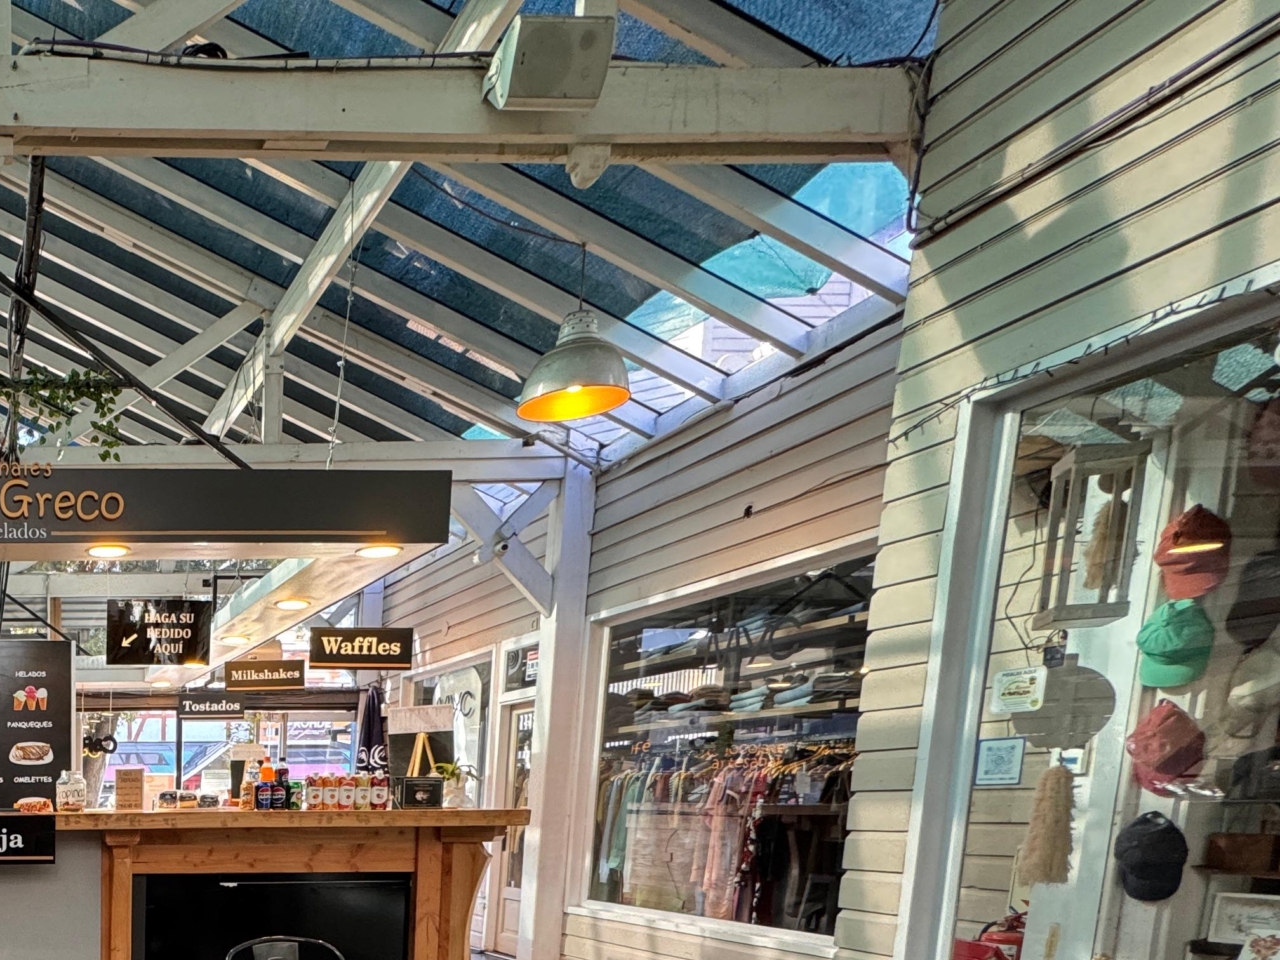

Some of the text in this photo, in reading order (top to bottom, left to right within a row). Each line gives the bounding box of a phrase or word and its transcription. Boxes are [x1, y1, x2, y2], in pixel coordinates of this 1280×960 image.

[0, 480, 125, 521] Greco
[144, 612, 195, 624] HAGA SU
[146, 628, 192, 639] PEDIDO
[153, 641, 183, 655] AQUÍ
[321, 636, 402, 656] Waffles
[231, 668, 301, 681] Milkshakes
[183, 700, 241, 712] Tostados
[7, 720, 53, 729] PANQUEQUES
